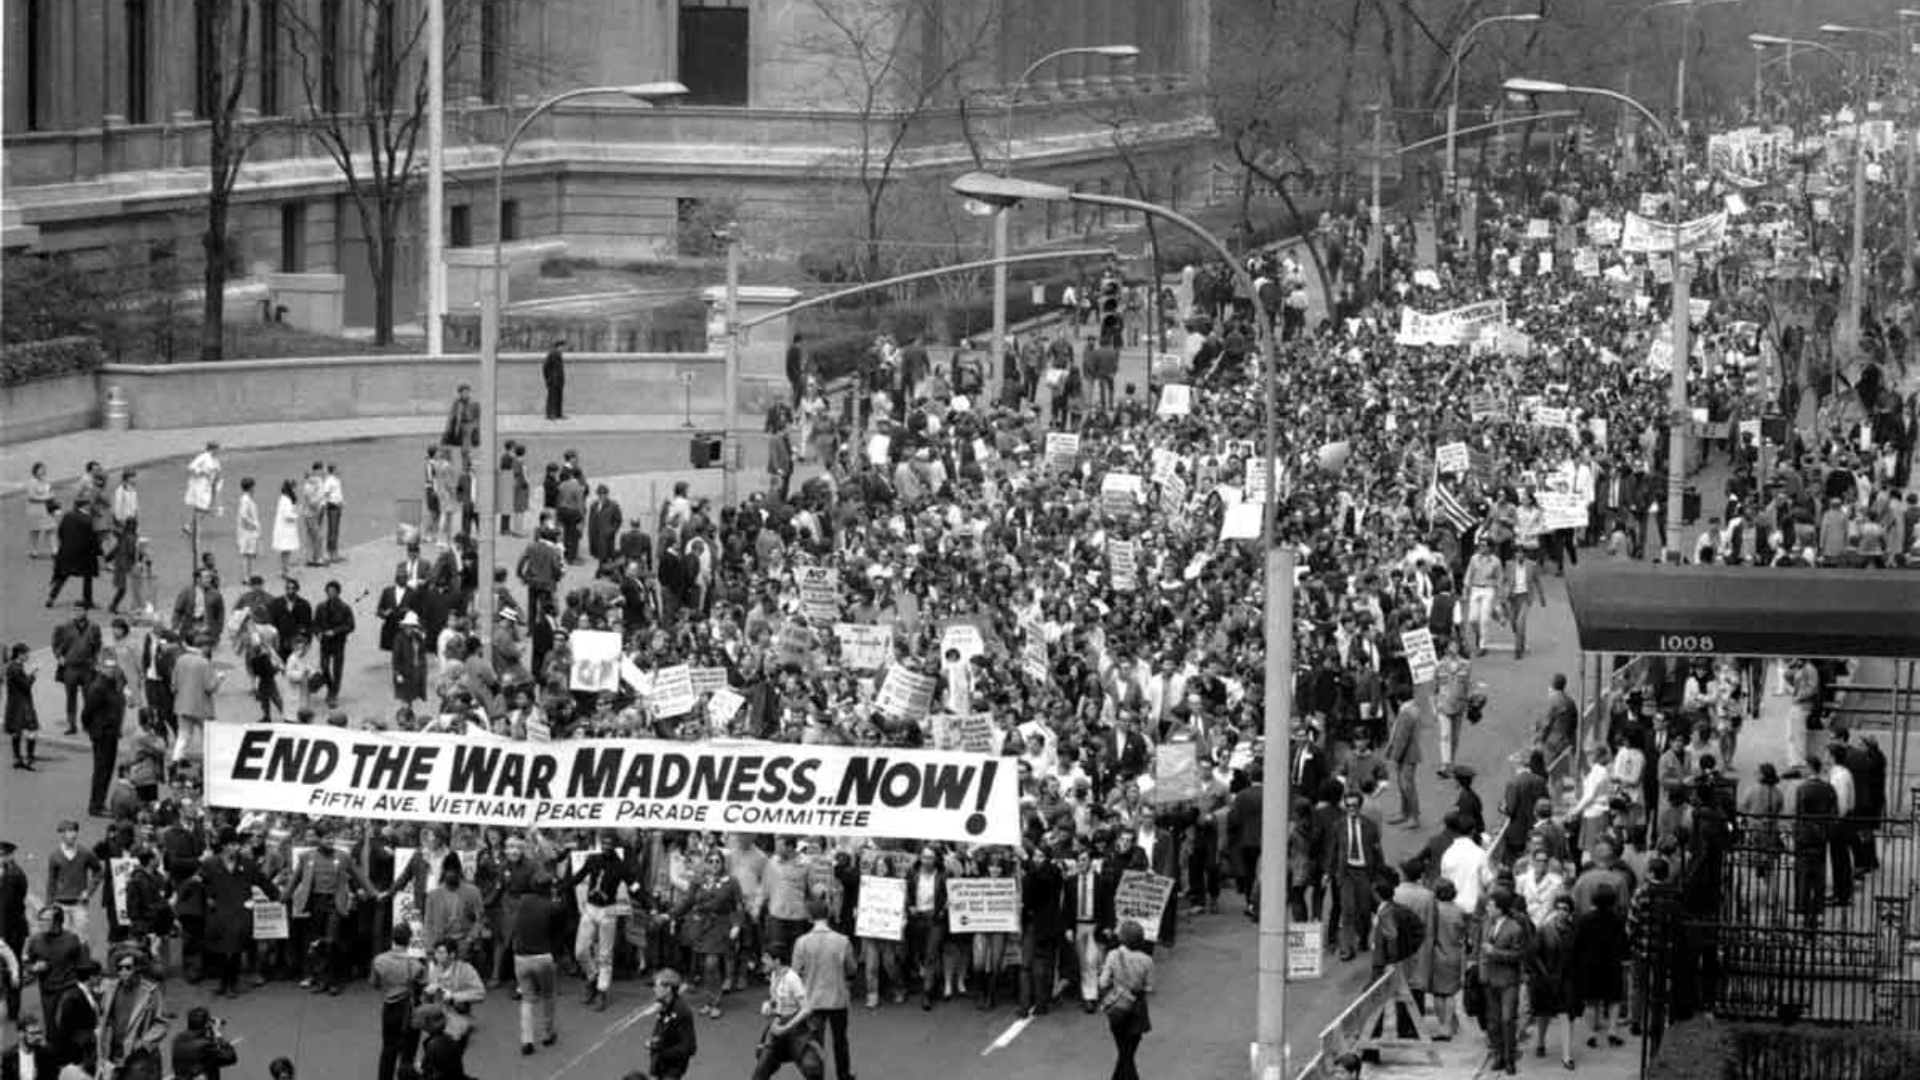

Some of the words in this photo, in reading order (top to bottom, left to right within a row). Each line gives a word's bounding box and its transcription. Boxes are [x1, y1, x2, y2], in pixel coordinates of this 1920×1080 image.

[1660, 634, 1714, 651] 1008
[231, 730, 340, 784] END
[350, 743, 441, 791] THE
[448, 745, 557, 799] WAR
[309, 789, 364, 809] FIFTH
[373, 794, 419, 813] AVE.
[430, 795, 526, 819] VIETNAM
[535, 801, 603, 821] PEACE
[616, 801, 709, 822] PARADE
[723, 804, 871, 827] COMMITTEE
